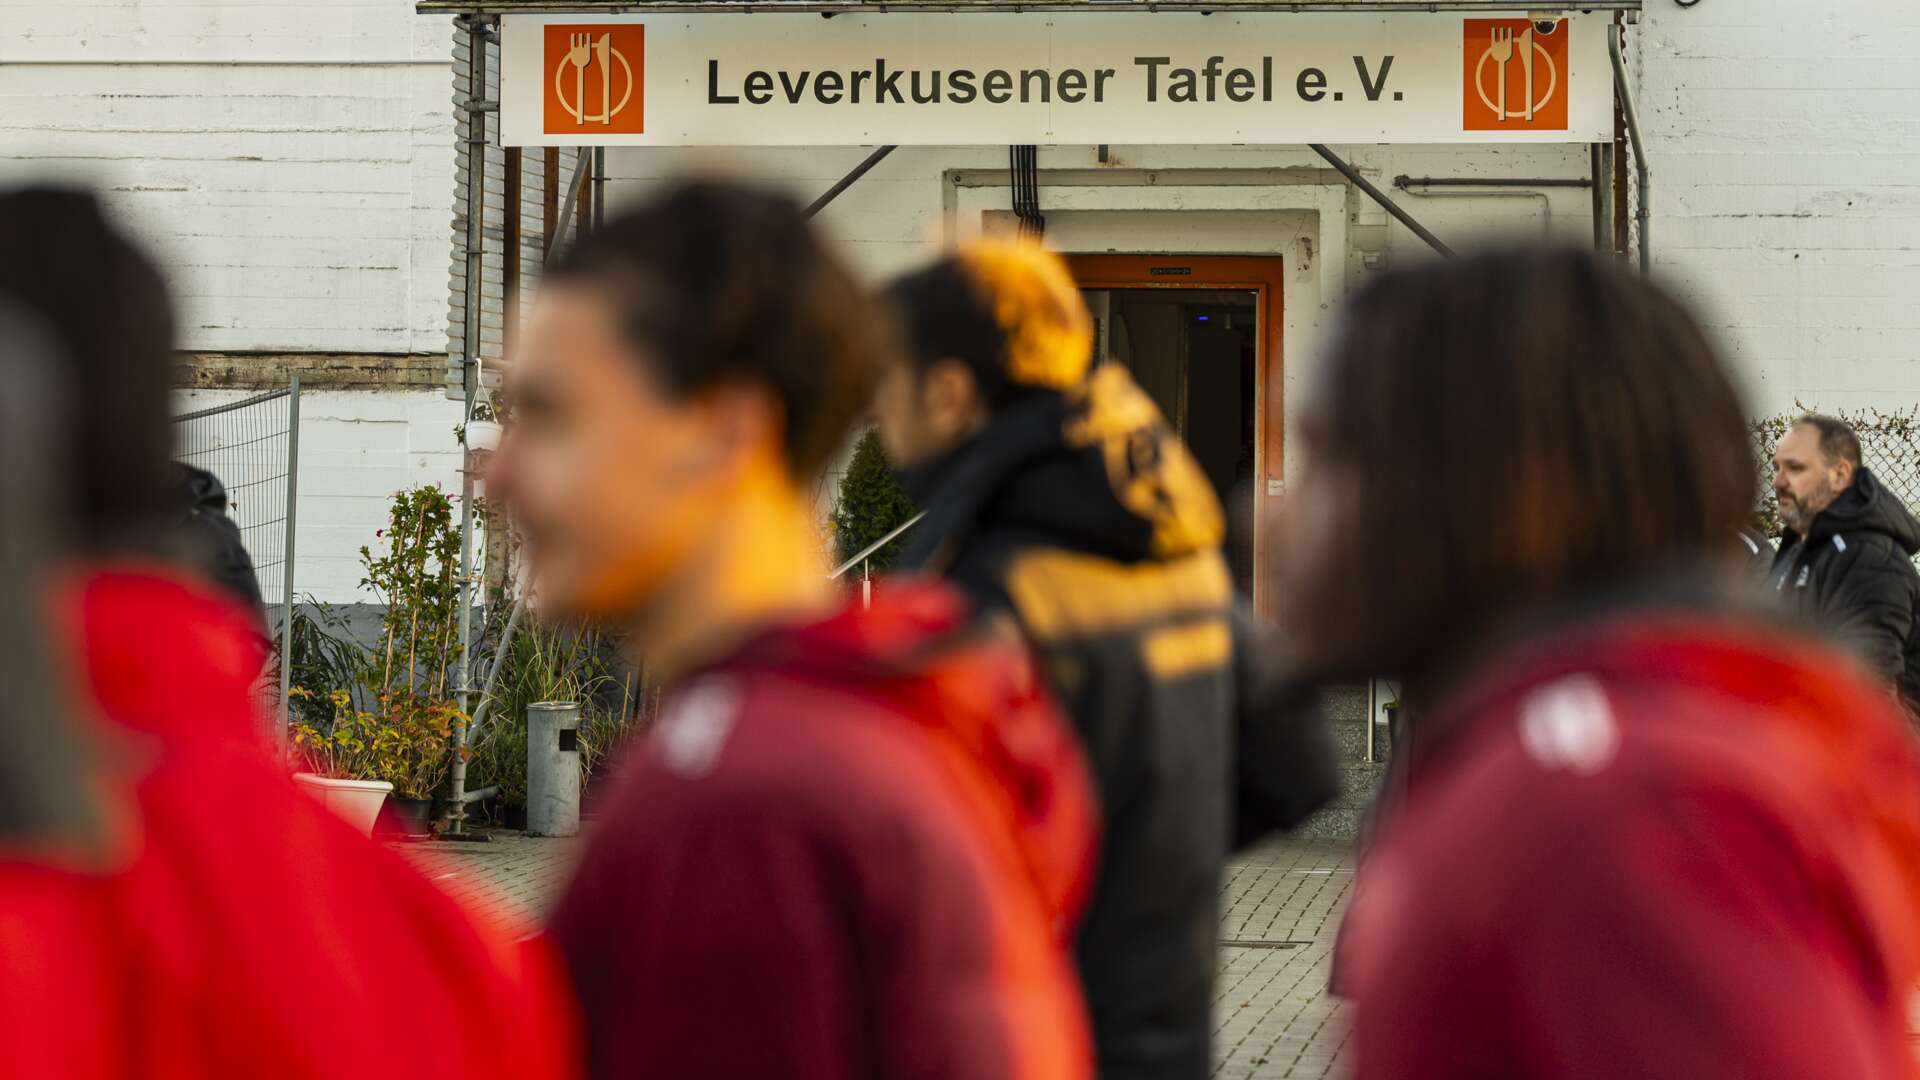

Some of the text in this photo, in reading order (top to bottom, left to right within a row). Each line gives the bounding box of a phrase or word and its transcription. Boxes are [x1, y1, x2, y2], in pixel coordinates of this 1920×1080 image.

[708, 55, 1403, 105] Leverkusener Tafel e. V.
